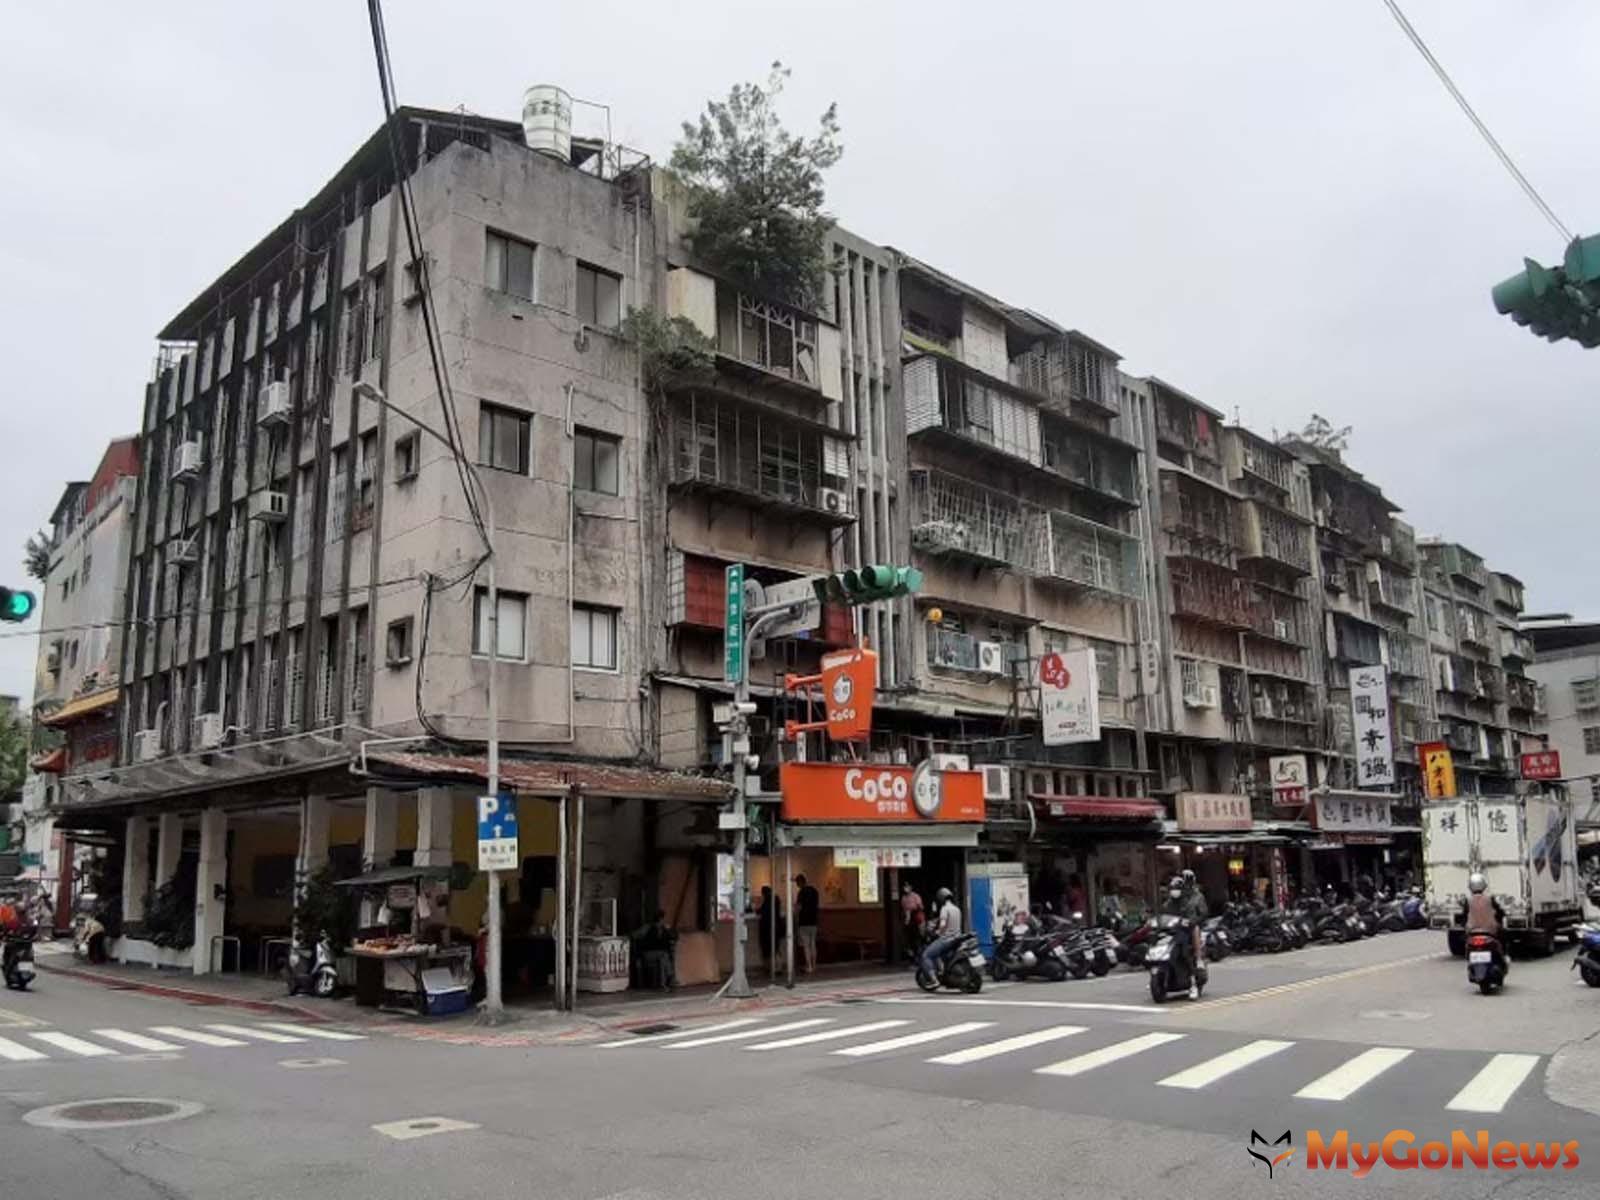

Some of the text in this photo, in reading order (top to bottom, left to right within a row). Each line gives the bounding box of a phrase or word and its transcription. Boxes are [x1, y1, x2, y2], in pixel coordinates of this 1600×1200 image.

[830, 708, 856, 721] CoCo
[845, 768, 908, 803] CoCo
[480, 797, 499, 823] P
